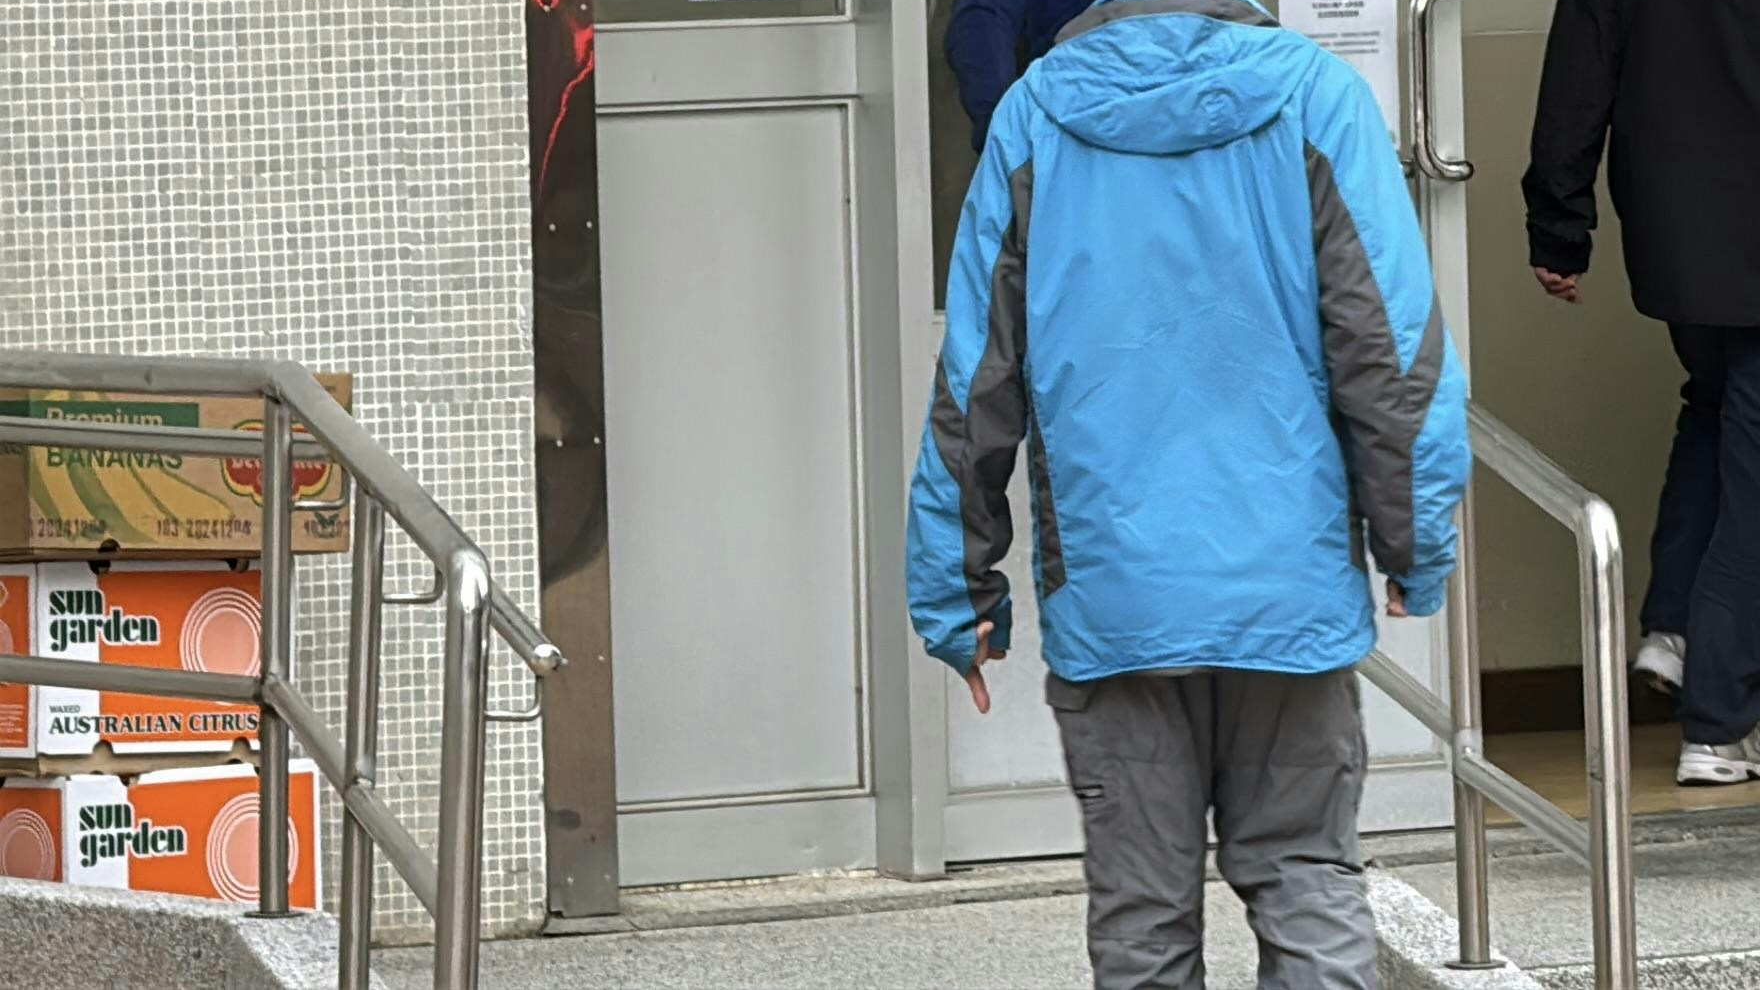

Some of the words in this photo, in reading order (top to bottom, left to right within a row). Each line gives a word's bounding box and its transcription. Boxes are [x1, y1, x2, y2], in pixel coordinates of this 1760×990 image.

[47, 446, 183, 470] BANANAS
[50, 591, 102, 615] sun
[50, 609, 157, 651] garden
[49, 705, 81, 714] WAXED
[50, 714, 182, 734] AUSTRALIAN
[189, 713, 258, 732] CITRUS
[79, 804, 132, 831] sun
[80, 822, 184, 868] garden
